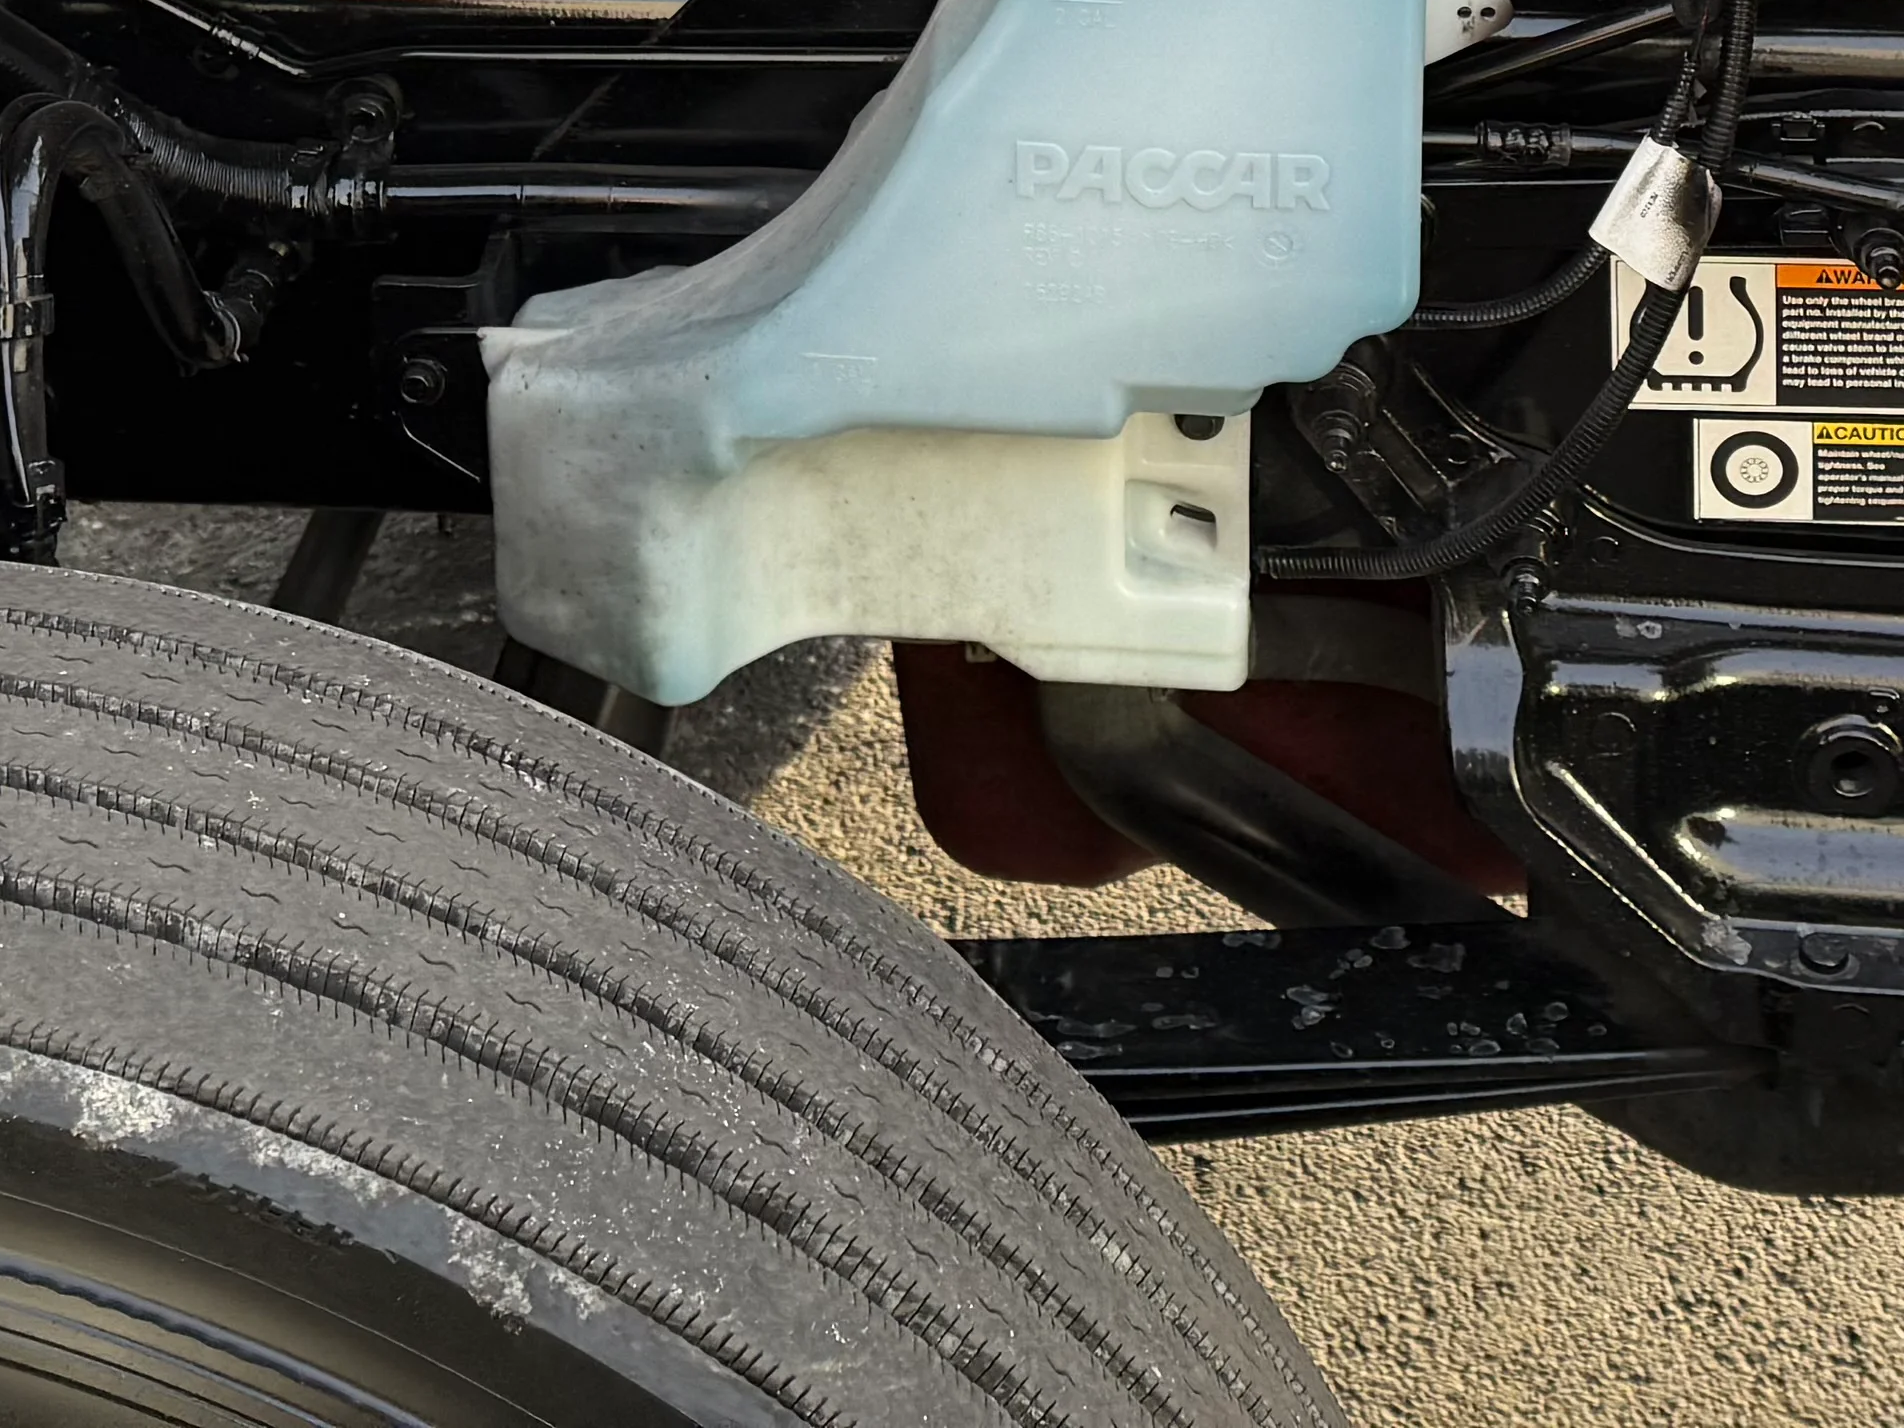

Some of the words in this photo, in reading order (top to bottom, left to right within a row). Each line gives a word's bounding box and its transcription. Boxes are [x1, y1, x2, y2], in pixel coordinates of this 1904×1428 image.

[1015, 139, 1332, 213] PACCAR
[1782, 295, 1803, 305] Use
[1806, 296, 1828, 307] only
[1831, 296, 1848, 305] the
[1851, 297, 1882, 306] wheel
[1782, 308, 1804, 318] part
[1806, 309, 1823, 317] no.
[1826, 308, 1871, 318] installed
[1873, 309, 1886, 319] by
[1782, 320, 1839, 330] equipment
[1782, 332, 1827, 341] different
[1830, 332, 1861, 341] wheel
[1863, 332, 1894, 342] brand
[1782, 344, 1815, 352] cause
[1817, 344, 1845, 352] valve
[1847, 344, 1874, 353] stem
[1876, 345, 1886, 353] to
[1783, 355, 1789, 363] a
[1792, 354, 1822, 363] brake
[1824, 355, 1884, 365] component
[1782, 366, 1805, 375] lead
[1807, 366, 1818, 375] to
[1821, 366, 1844, 375] loss
[1846, 366, 1857, 376] of
[1859, 367, 1897, 376] vehicle
[1782, 379, 1805, 388] may
[1807, 378, 1830, 387] lead
[1832, 378, 1844, 387] to
[1846, 379, 1892, 388] personal
